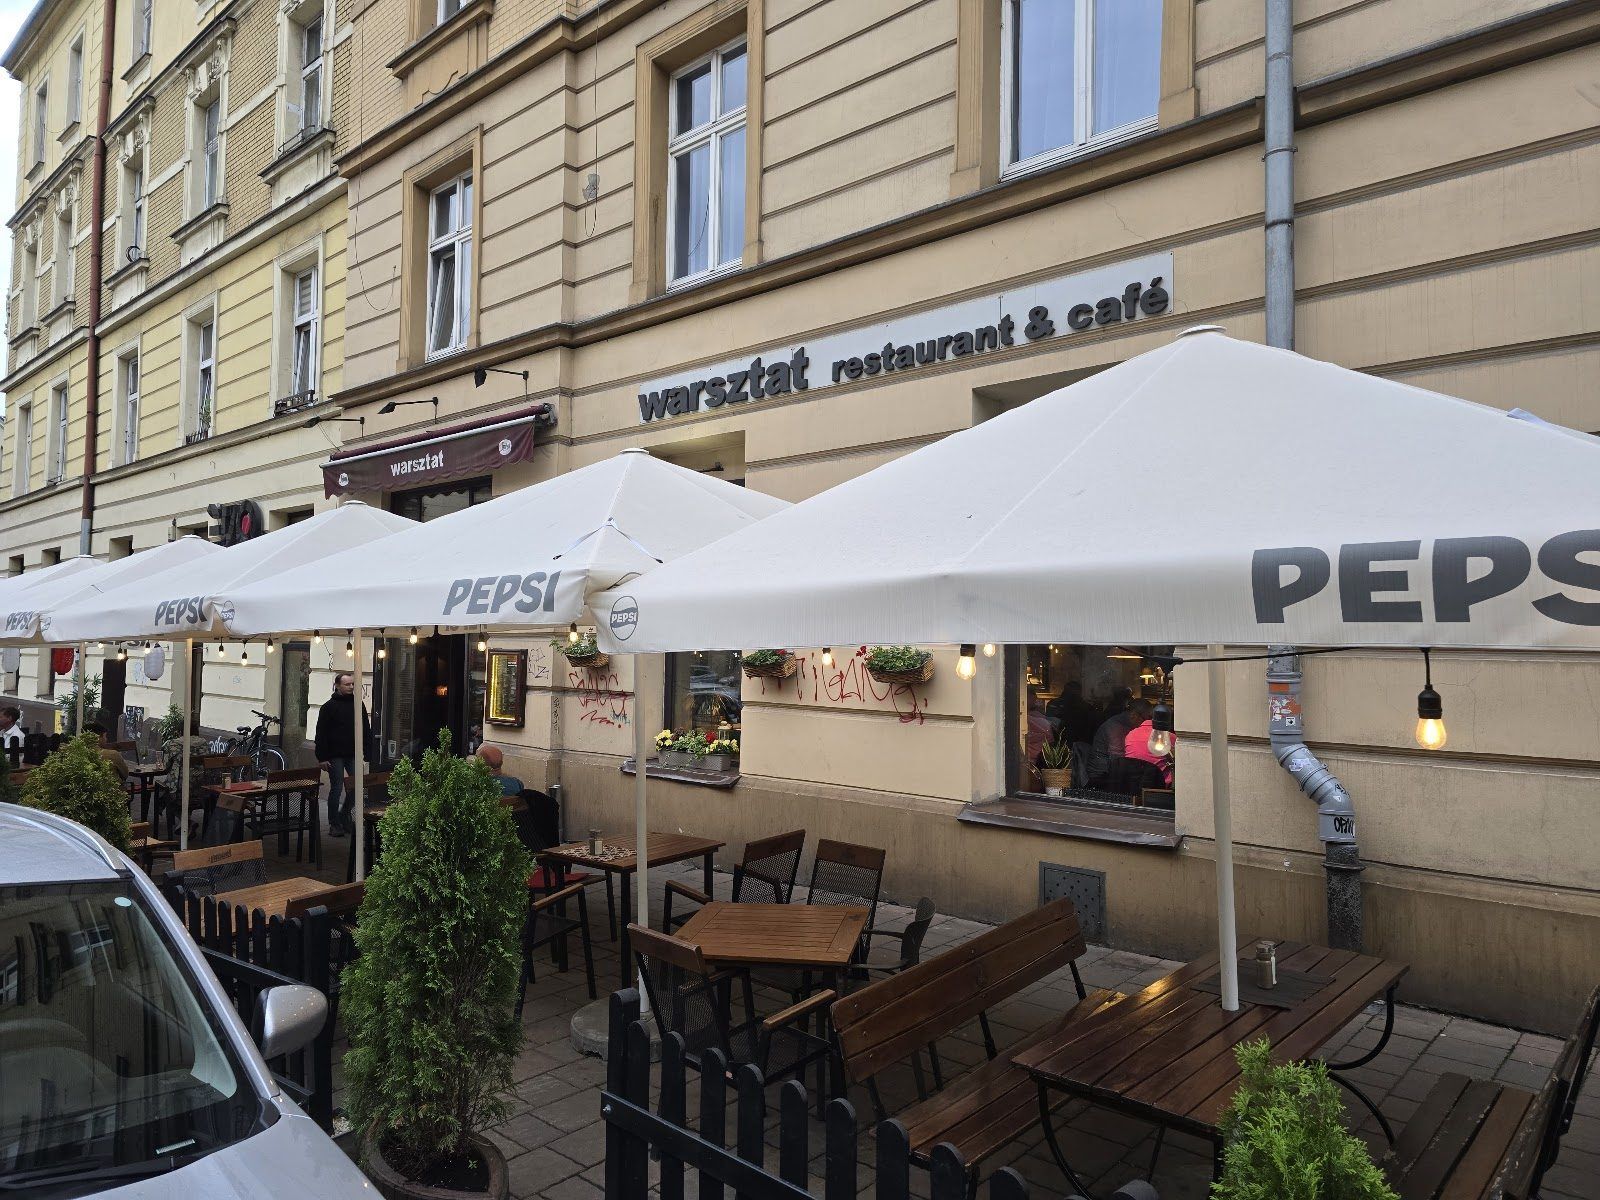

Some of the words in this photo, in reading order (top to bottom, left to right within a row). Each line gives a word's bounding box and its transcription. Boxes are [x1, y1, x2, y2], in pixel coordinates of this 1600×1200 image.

[638, 347, 810, 421] warsztat
[831, 316, 1015, 382] restaurant
[1023, 305, 1056, 340] &
[1067, 278, 1170, 330] café
[390, 450, 444, 477] warsztat
[442, 570, 562, 616] PEPSI
[154, 595, 208, 627] PEPSI
[611, 611, 638, 624] PEPSI
